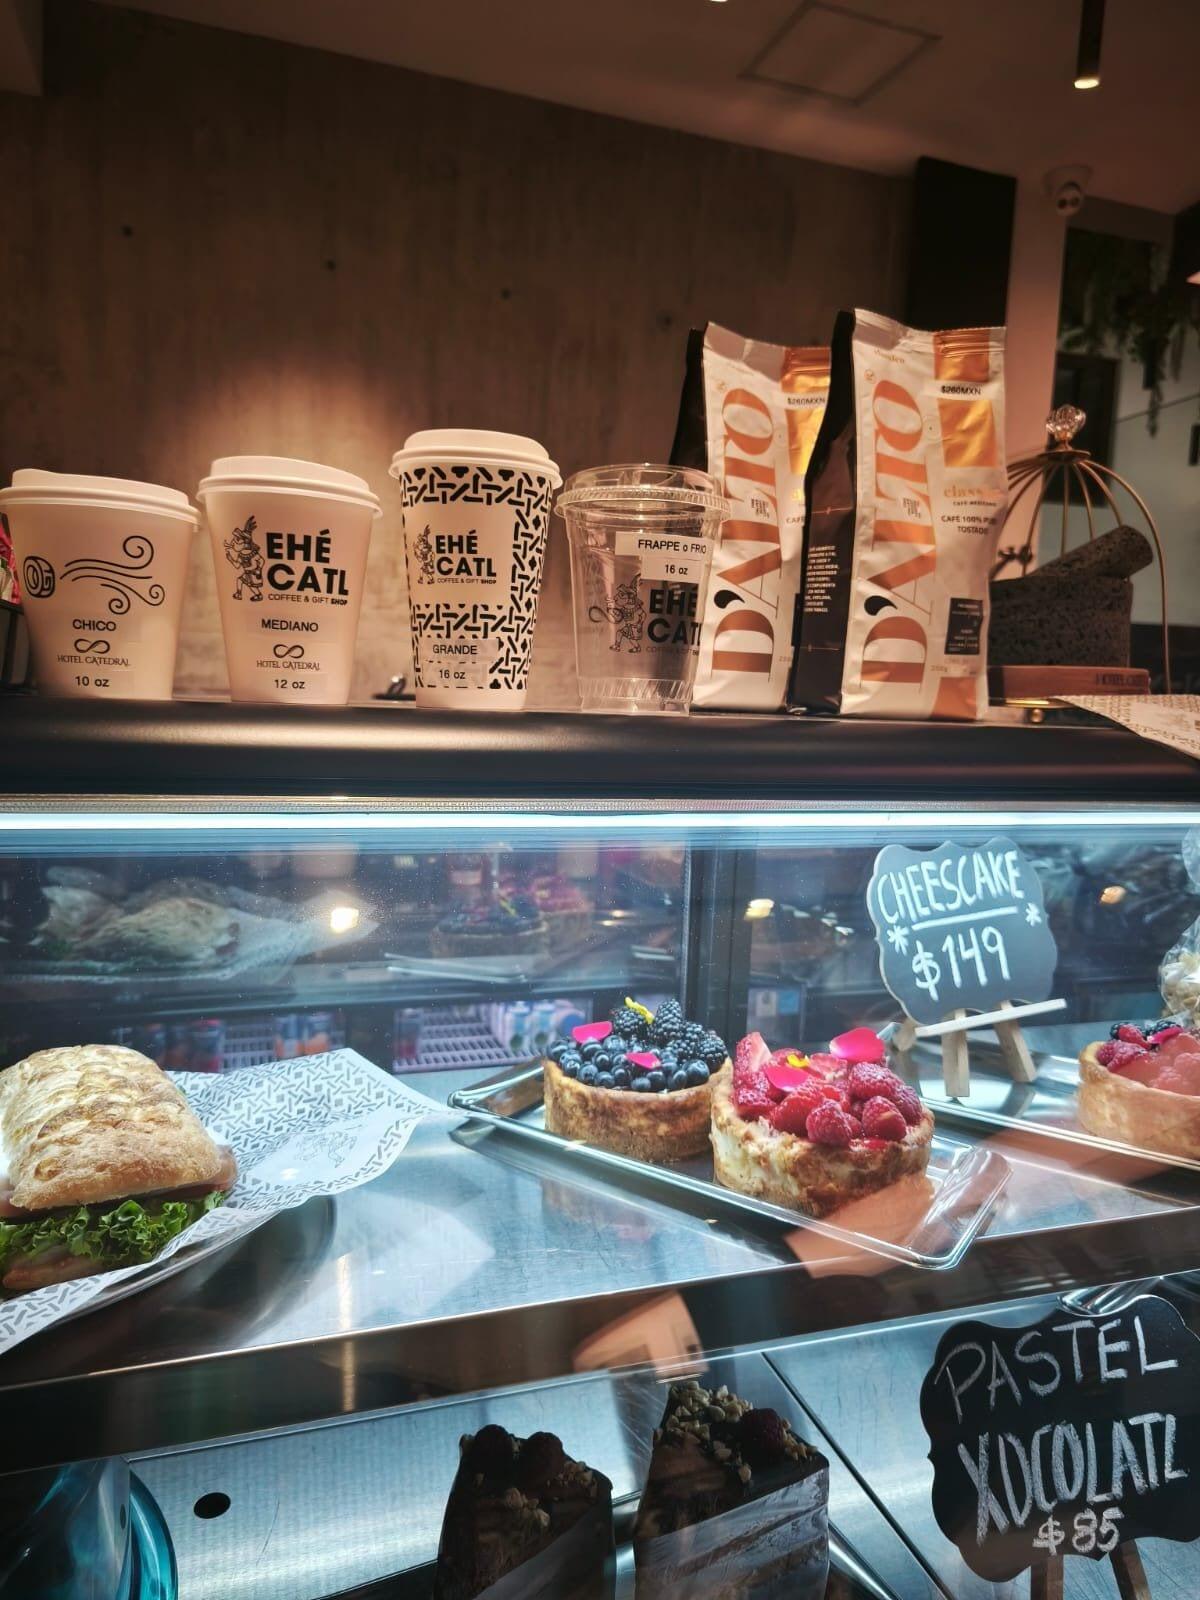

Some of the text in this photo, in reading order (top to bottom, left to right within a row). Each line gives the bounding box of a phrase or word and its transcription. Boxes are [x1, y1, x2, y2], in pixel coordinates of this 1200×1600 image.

[266, 528, 331, 564] EHÉ
[435, 528, 478, 555] EHÉ
[637, 538, 707, 555] FRAPPE o FRIO
[436, 556, 497, 578] CATL
[664, 564, 689, 576] 16 oz
[266, 563, 349, 597] CATL
[267, 593, 348, 606] COFFEE & GIFT SHOP
[72, 618, 117, 633] CHICO
[261, 618, 319, 633] MEDIANO
[432, 643, 478, 656] GRANDE
[57, 654, 131, 668] HOTEL CATEDRAL
[256, 659, 321, 672] HOTEL CATEDRAL
[75, 676, 110, 688] 10 oz
[438, 669, 466, 681] 16 oz
[274, 679, 305, 690] 12 oz
[877, 851, 1025, 924] CHEESCAKE
[912, 926, 1011, 1002] $149
[934, 1315, 1179, 1424] PASTEL
